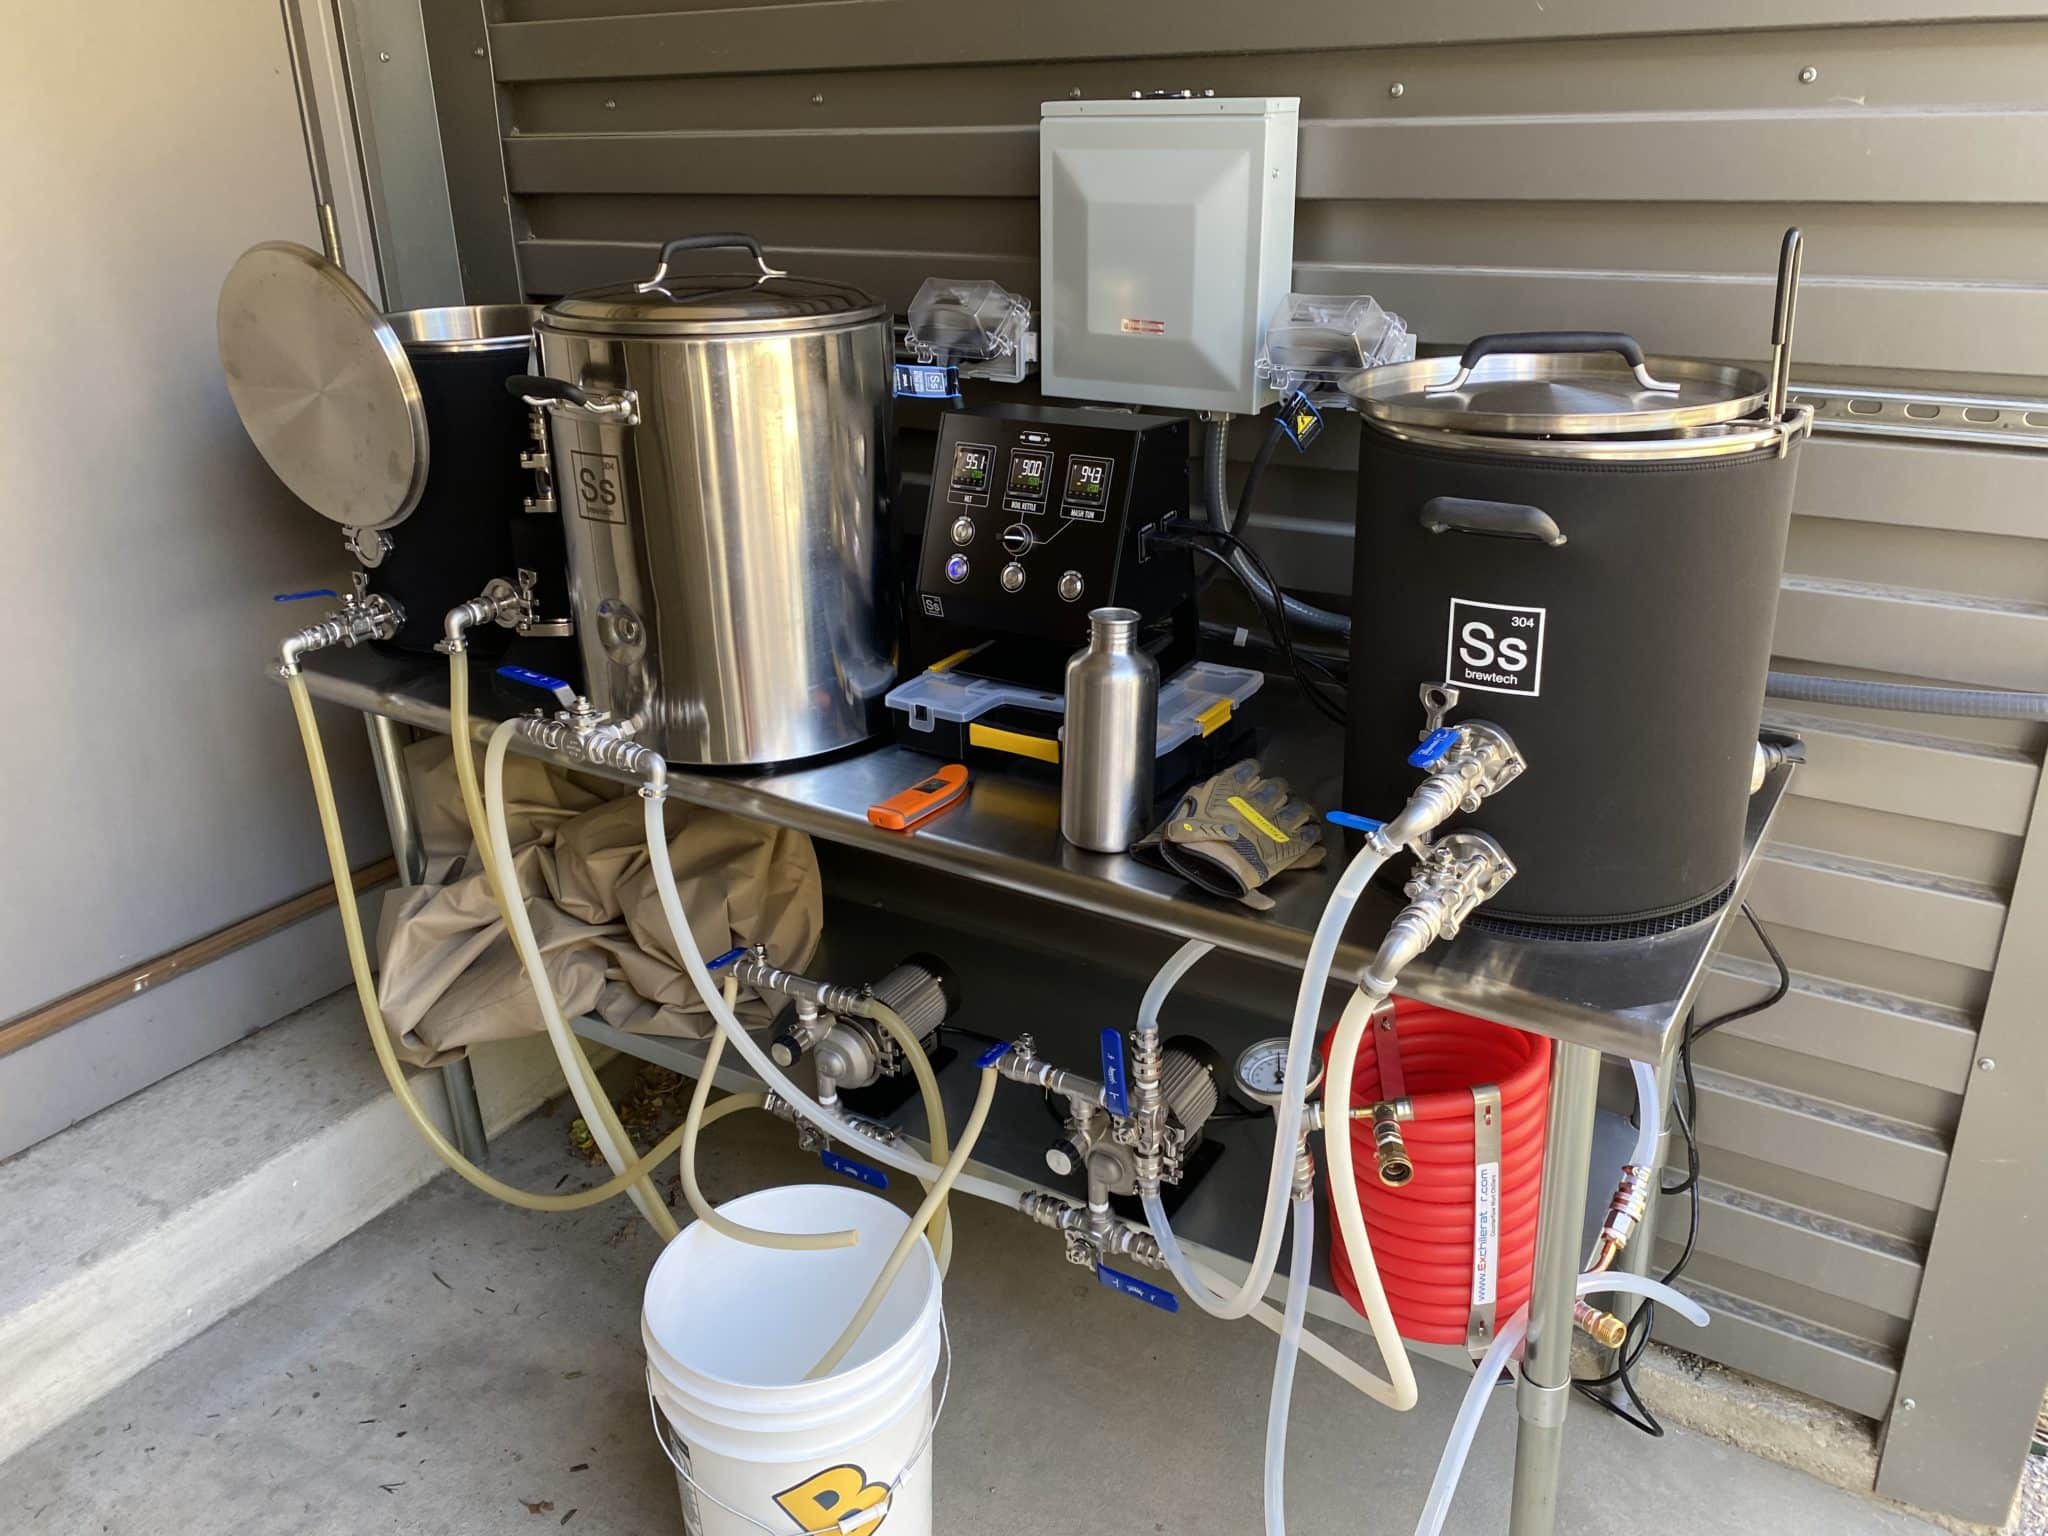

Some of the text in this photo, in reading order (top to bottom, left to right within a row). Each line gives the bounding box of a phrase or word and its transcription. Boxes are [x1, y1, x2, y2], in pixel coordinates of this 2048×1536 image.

[580, 467, 616, 505] Ss
[1511, 616, 1535, 628] 304
[1459, 621, 1528, 672] Ss
[1464, 667, 1518, 685] brewtech
